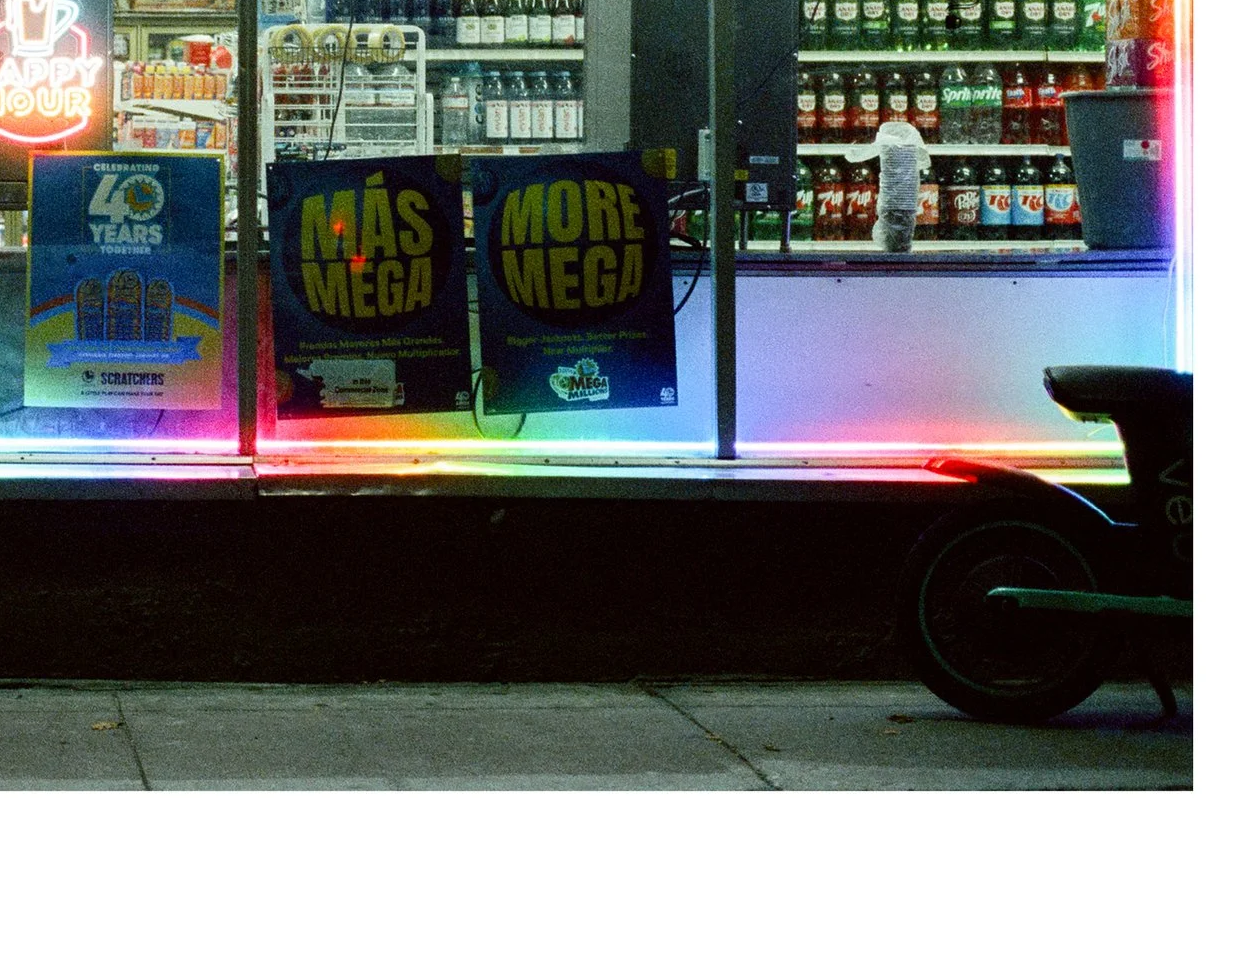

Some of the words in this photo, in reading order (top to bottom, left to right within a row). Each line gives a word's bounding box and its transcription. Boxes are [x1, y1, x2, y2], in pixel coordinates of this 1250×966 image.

[93, 163, 160, 172] CELEBRATING
[88, 173, 164, 224] 40
[301, 170, 434, 260] MÁS
[501, 179, 645, 246] MORE
[88, 223, 163, 245] YEARS
[100, 246, 152, 254] TOGETHER
[301, 256, 433, 318] MEGA
[501, 243, 643, 309] MEGA
[100, 372, 165, 386] SCRATCHERS
[570, 375, 608, 391] MEGA
